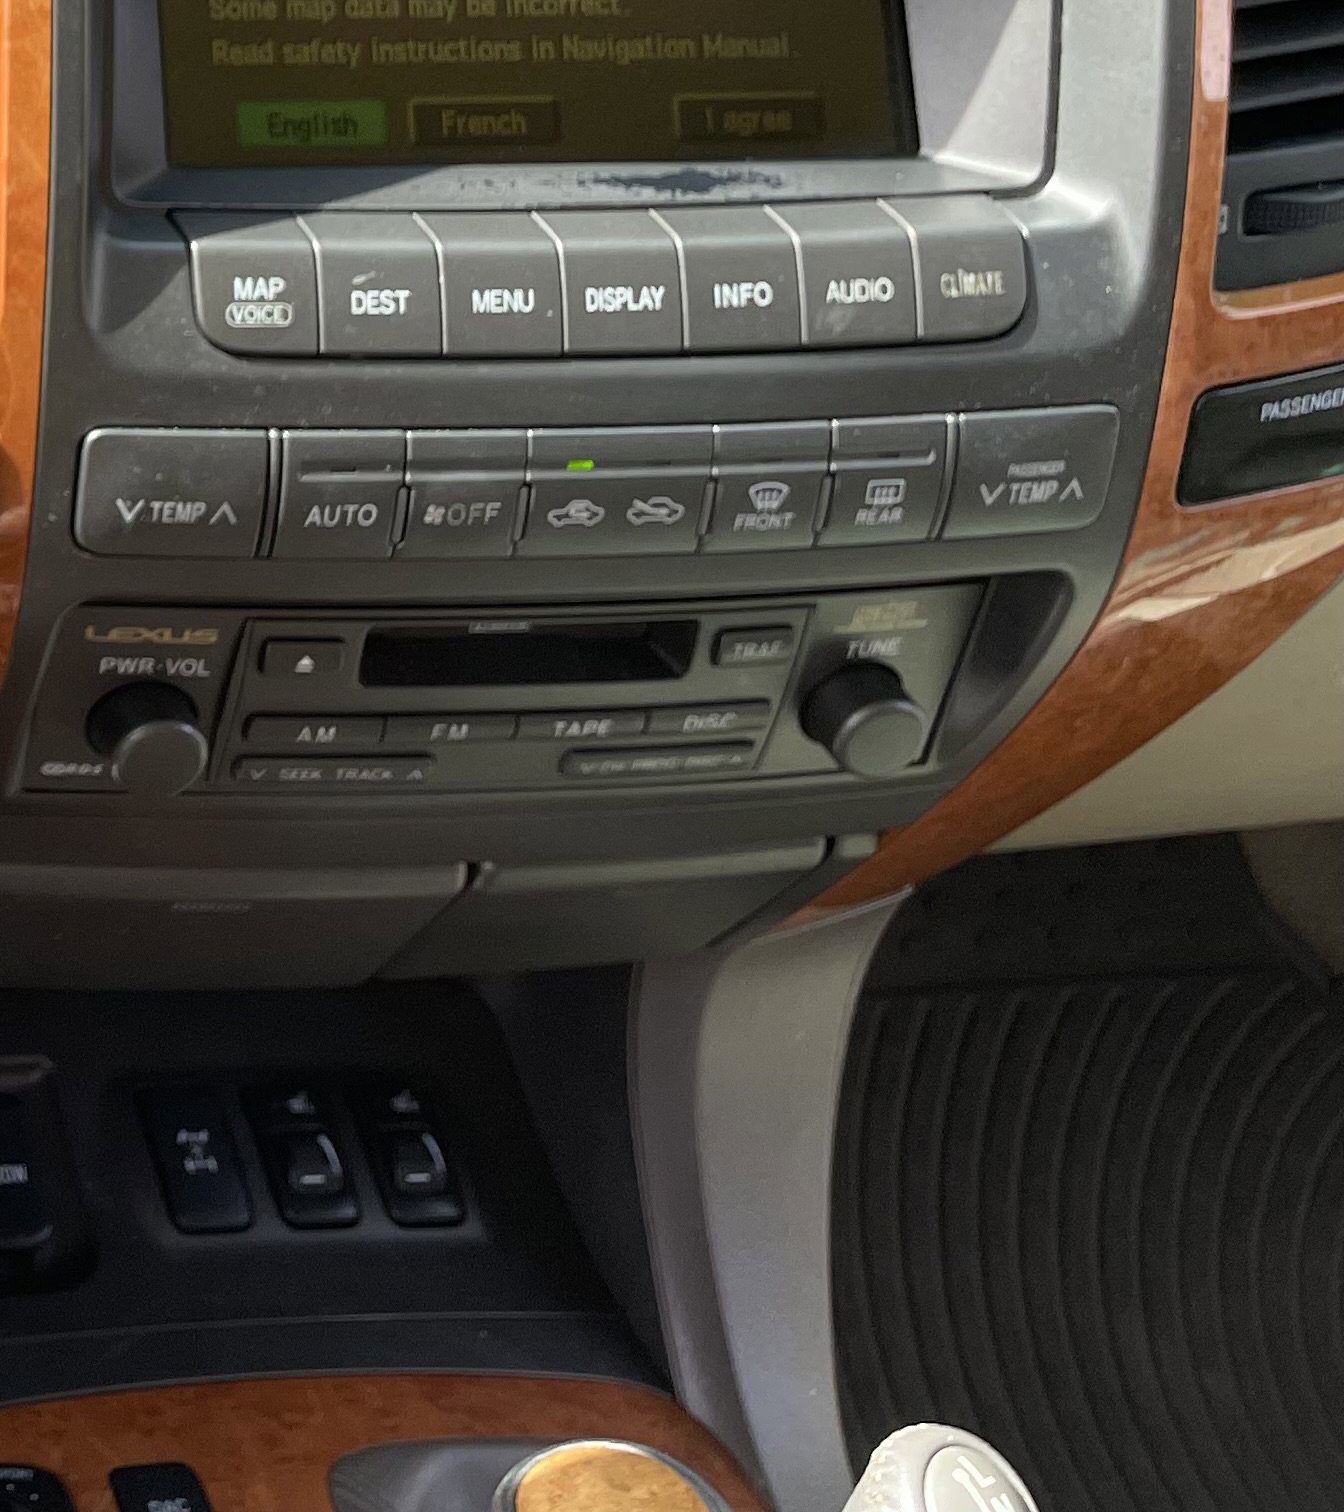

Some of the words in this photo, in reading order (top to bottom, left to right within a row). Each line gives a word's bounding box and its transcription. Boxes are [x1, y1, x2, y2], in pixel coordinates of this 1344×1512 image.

[212, 39, 274, 67] Read
[281, 37, 362, 70] safety
[370, 35, 522, 65] instructions
[531, 34, 555, 61] in
[561, 32, 696, 65] Navigation
[267, 110, 360, 144] English
[441, 108, 528, 137] French
[232, 276, 287, 301] MAP
[712, 280, 774, 310] INFO
[825, 276, 896, 305] AUDIO
[939, 268, 1008, 299] CLIMATE
[350, 289, 411, 316] DEST
[471, 287, 536, 315] MENU
[584, 285, 666, 313] DISPLAY
[229, 302, 289, 326] VOICE
[1009, 479, 1059, 505] TEMP
[148, 500, 207, 526] TEMP
[303, 502, 379, 528] AUTO
[446, 501, 503, 527] OFF
[732, 512, 796, 532] FRONT
[854, 506, 904, 526] REAR
[84, 624, 220, 645] LEXUS
[845, 635, 903, 660] TUNE
[295, 724, 338, 745] AM
[429, 722, 470, 741] FM
[553, 718, 613, 738] TAPE
[681, 710, 738, 734] DISC
[278, 767, 324, 782] SEEK
[335, 766, 394, 782] TRACK
